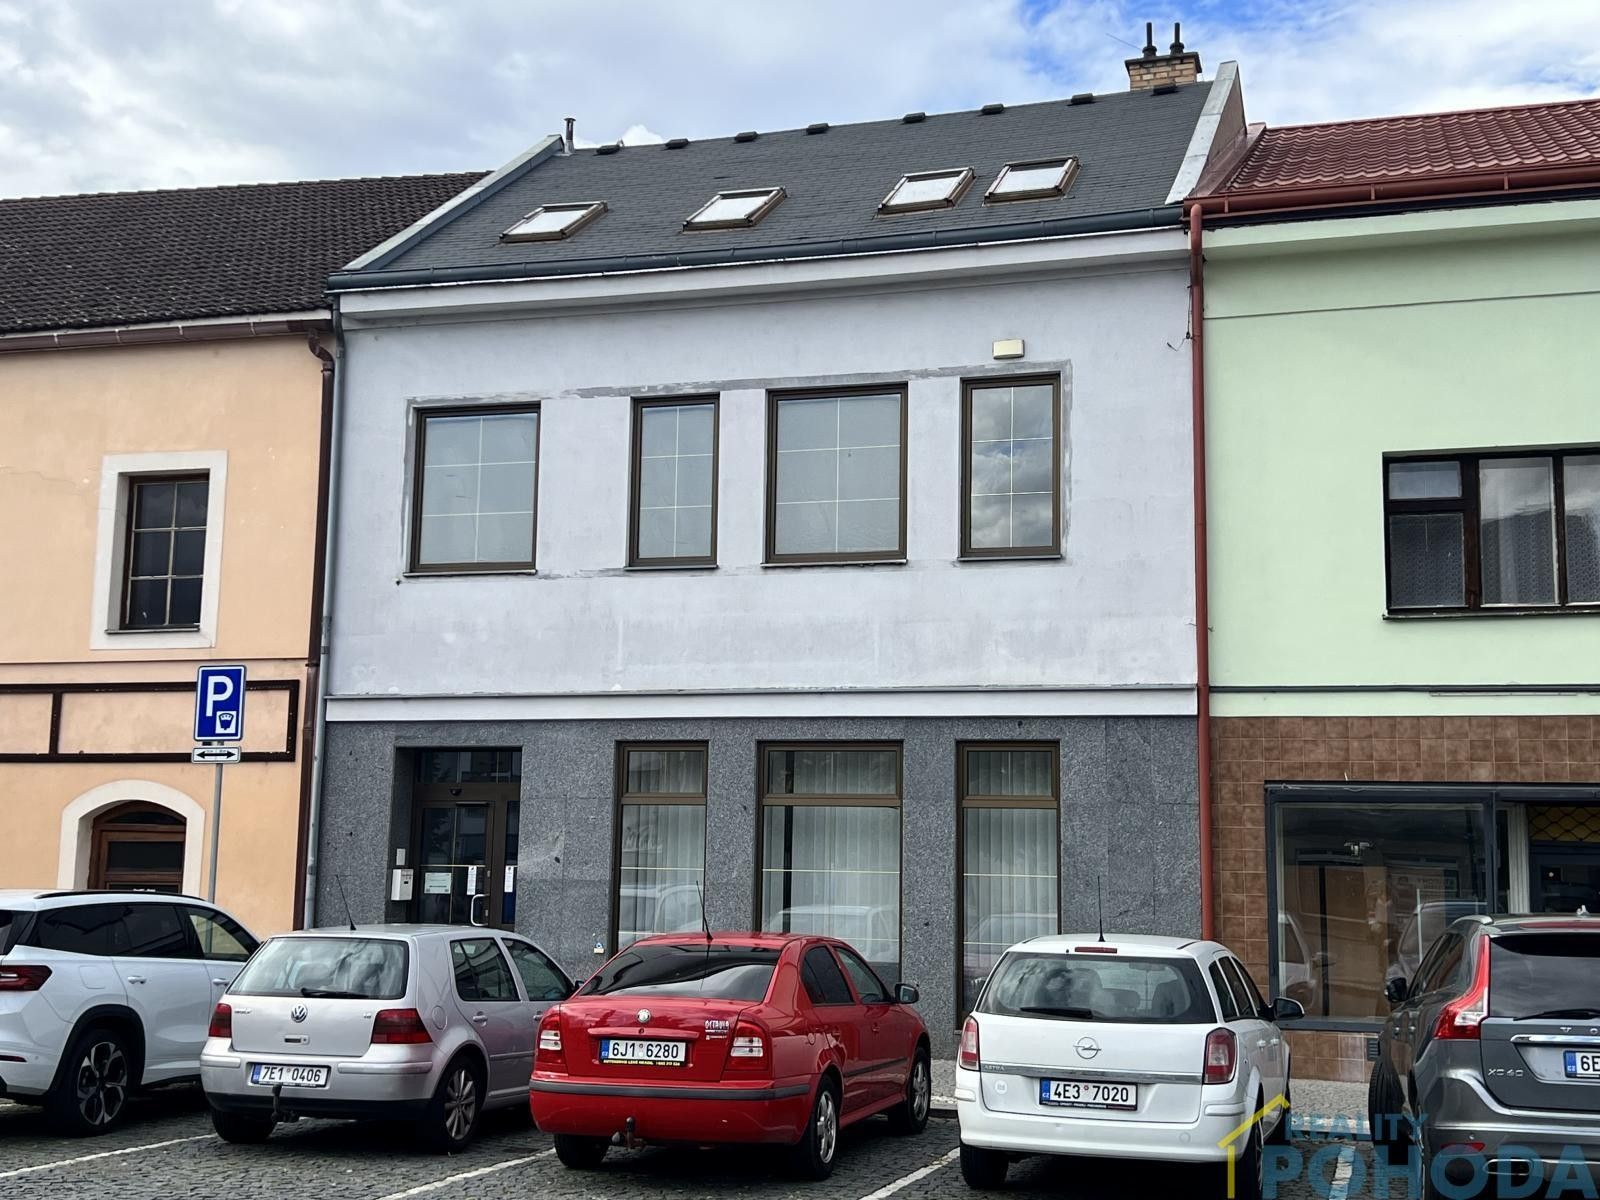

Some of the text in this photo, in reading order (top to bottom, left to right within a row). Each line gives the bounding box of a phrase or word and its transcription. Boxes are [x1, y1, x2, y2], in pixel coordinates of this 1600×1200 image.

[206, 675, 234, 717] P
[612, 1042, 679, 1059] 6J1 6280
[1580, 1055, 1600, 1072] 6E
[262, 1066, 283, 1081] 7E1
[291, 1068, 321, 1082] 0406
[1054, 1083, 1129, 1102] 4E3 7020
